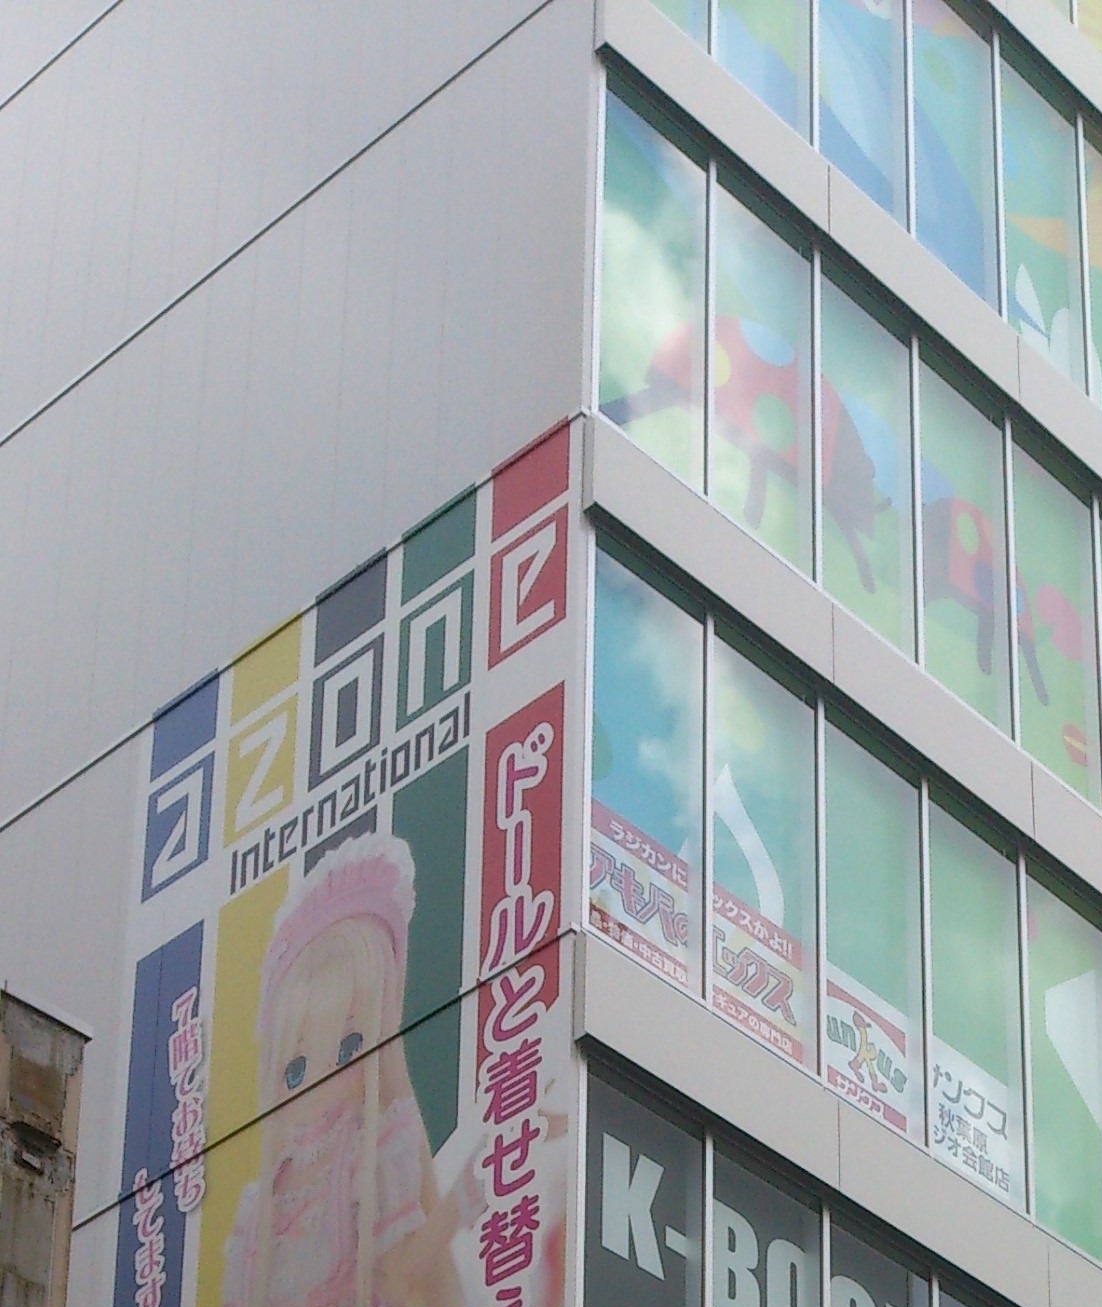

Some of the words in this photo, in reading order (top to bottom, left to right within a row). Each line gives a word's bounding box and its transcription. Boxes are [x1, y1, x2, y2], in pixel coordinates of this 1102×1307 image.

[230, 692, 470, 896] International
[827, 1012, 906, 1094] unkus
[938, 1103, 989, 1155] 秋葉原
